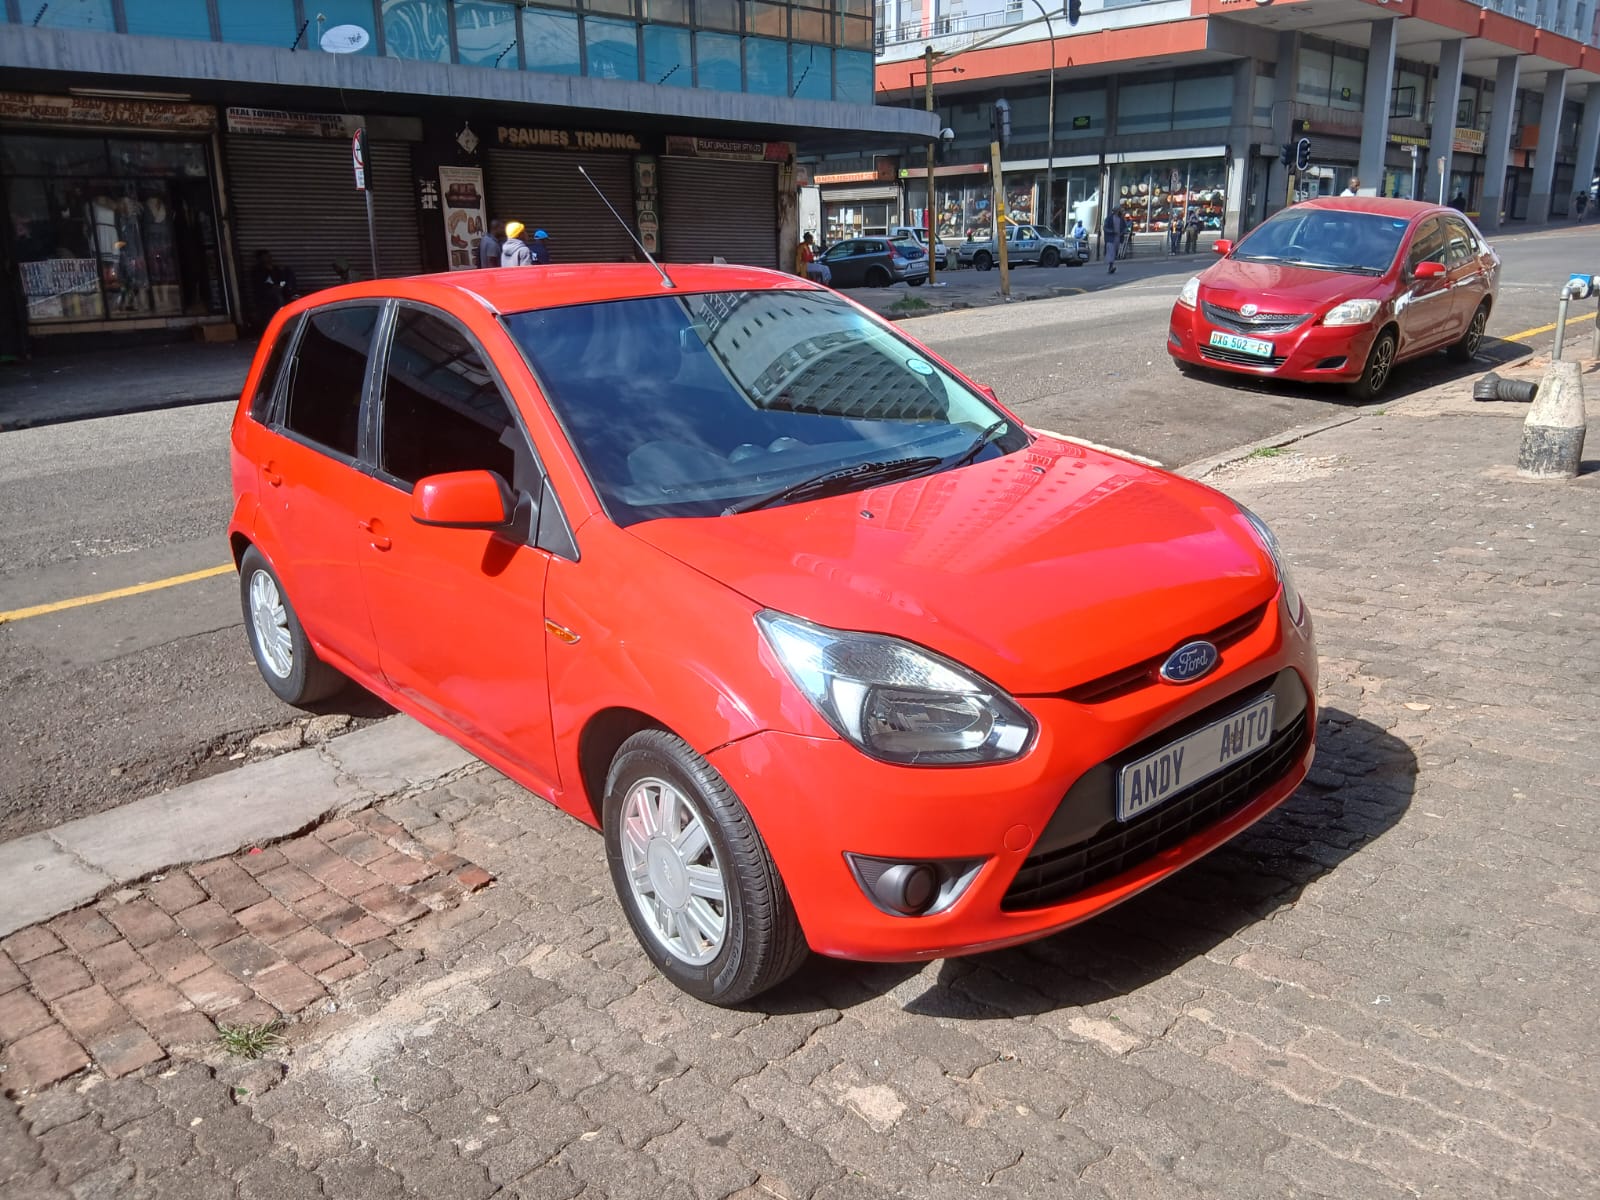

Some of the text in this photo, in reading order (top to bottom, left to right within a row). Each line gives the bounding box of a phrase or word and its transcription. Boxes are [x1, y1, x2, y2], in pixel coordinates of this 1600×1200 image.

[229, 108, 250, 117] REAL
[252, 109, 288, 120] TOWERS
[497, 126, 569, 146] PSAUMES
[1212, 333, 1270, 355] DXG 502 FS
[1177, 648, 1208, 675] Ford
[1130, 705, 1269, 810] ANDY AUTO
